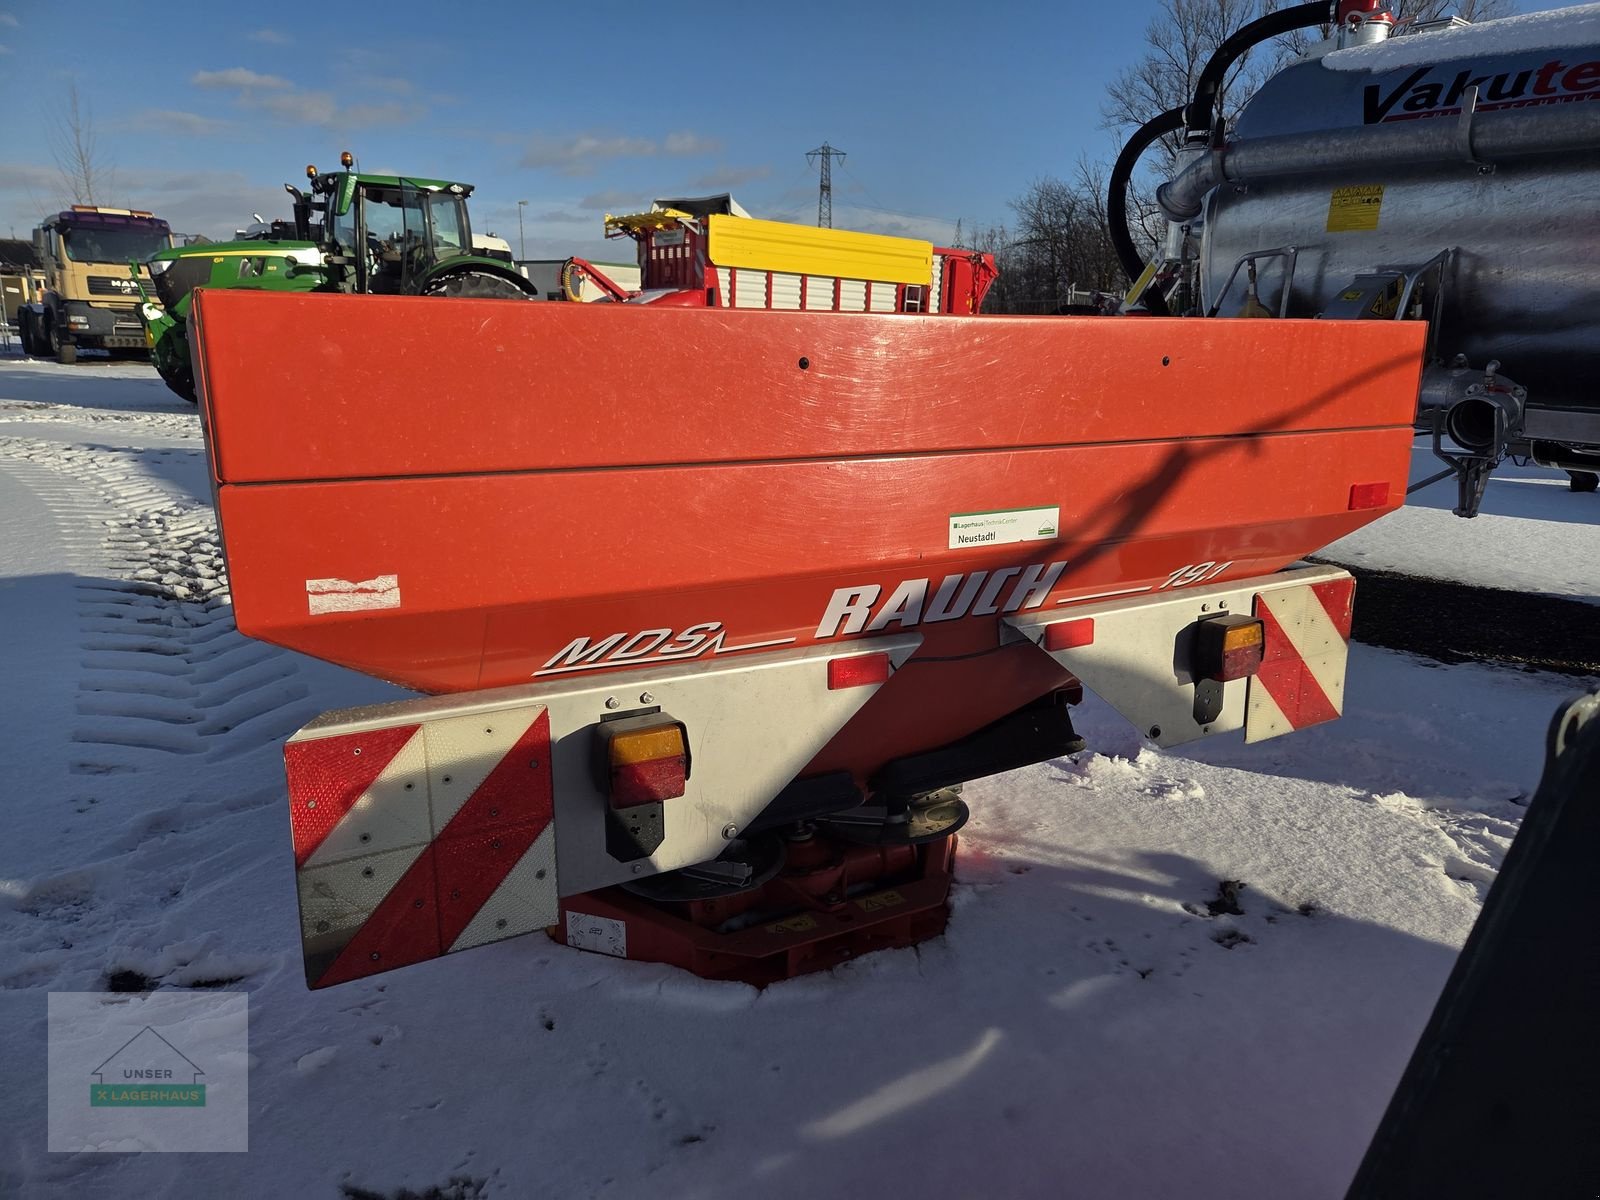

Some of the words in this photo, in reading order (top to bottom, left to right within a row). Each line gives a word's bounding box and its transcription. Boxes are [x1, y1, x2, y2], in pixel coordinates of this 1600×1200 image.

[958, 531, 996, 543] Neustadtl
[814, 560, 1068, 639] RAUCH
[541, 621, 722, 669] MDS
